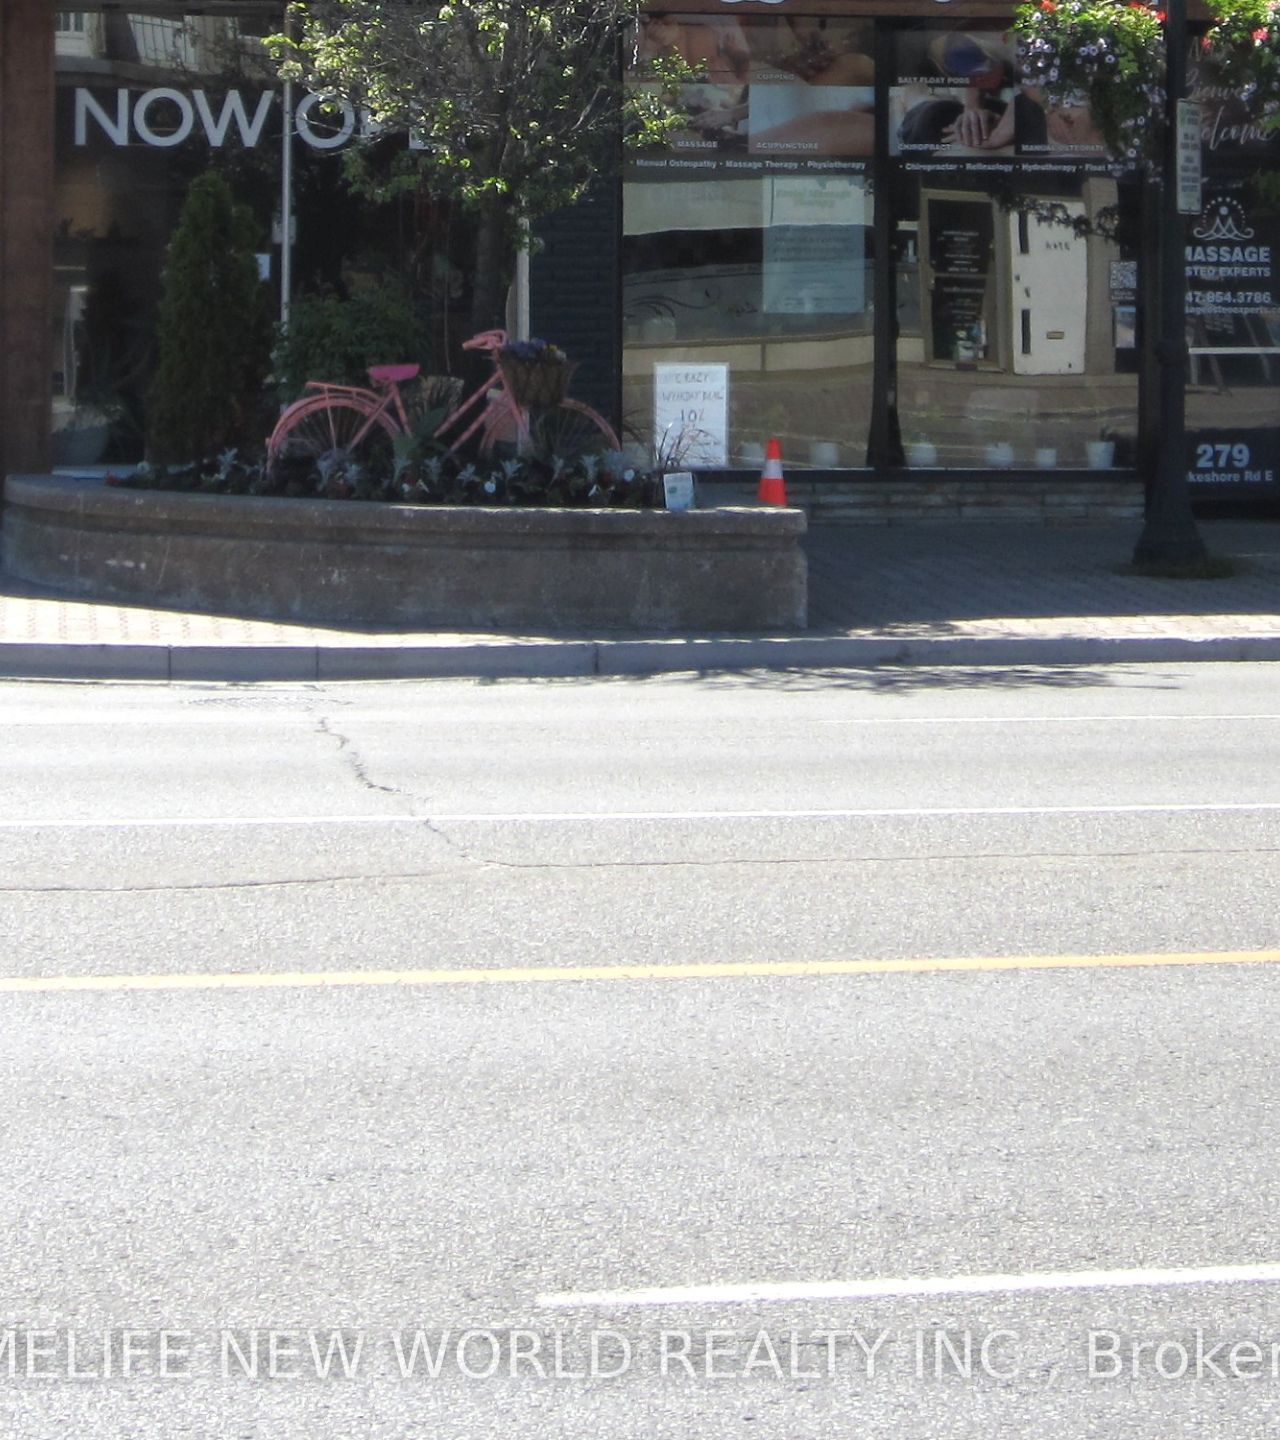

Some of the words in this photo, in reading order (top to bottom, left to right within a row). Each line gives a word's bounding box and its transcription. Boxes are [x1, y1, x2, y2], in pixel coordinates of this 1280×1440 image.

[897, 76, 918, 85] SALT
[920, 76, 945, 85] FLOAT
[74, 87, 275, 148] NOW
[1201, 104, 1278, 151] elcome
[677, 140, 719, 148] MASSAGE
[636, 159, 667, 167] Manual
[669, 160, 717, 169] Osteopathy
[725, 160, 763, 169] Massage
[765, 161, 799, 170] Therapy
[807, 161, 866, 170] Physiotherapy
[905, 163, 957, 172] Chiropractor
[1022, 163, 1077, 172] Hydrotherapy
[1185, 266, 1216, 277] STEO
[1219, 266, 1272, 278] EXPERTS
[1185, 291, 1272, 304] 47.854.3786
[1196, 443, 1251, 468] 279
[1186, 471, 1241, 482] keshore
[1244, 470, 1261, 482] Rd
[1264, 470, 1273, 482] E
